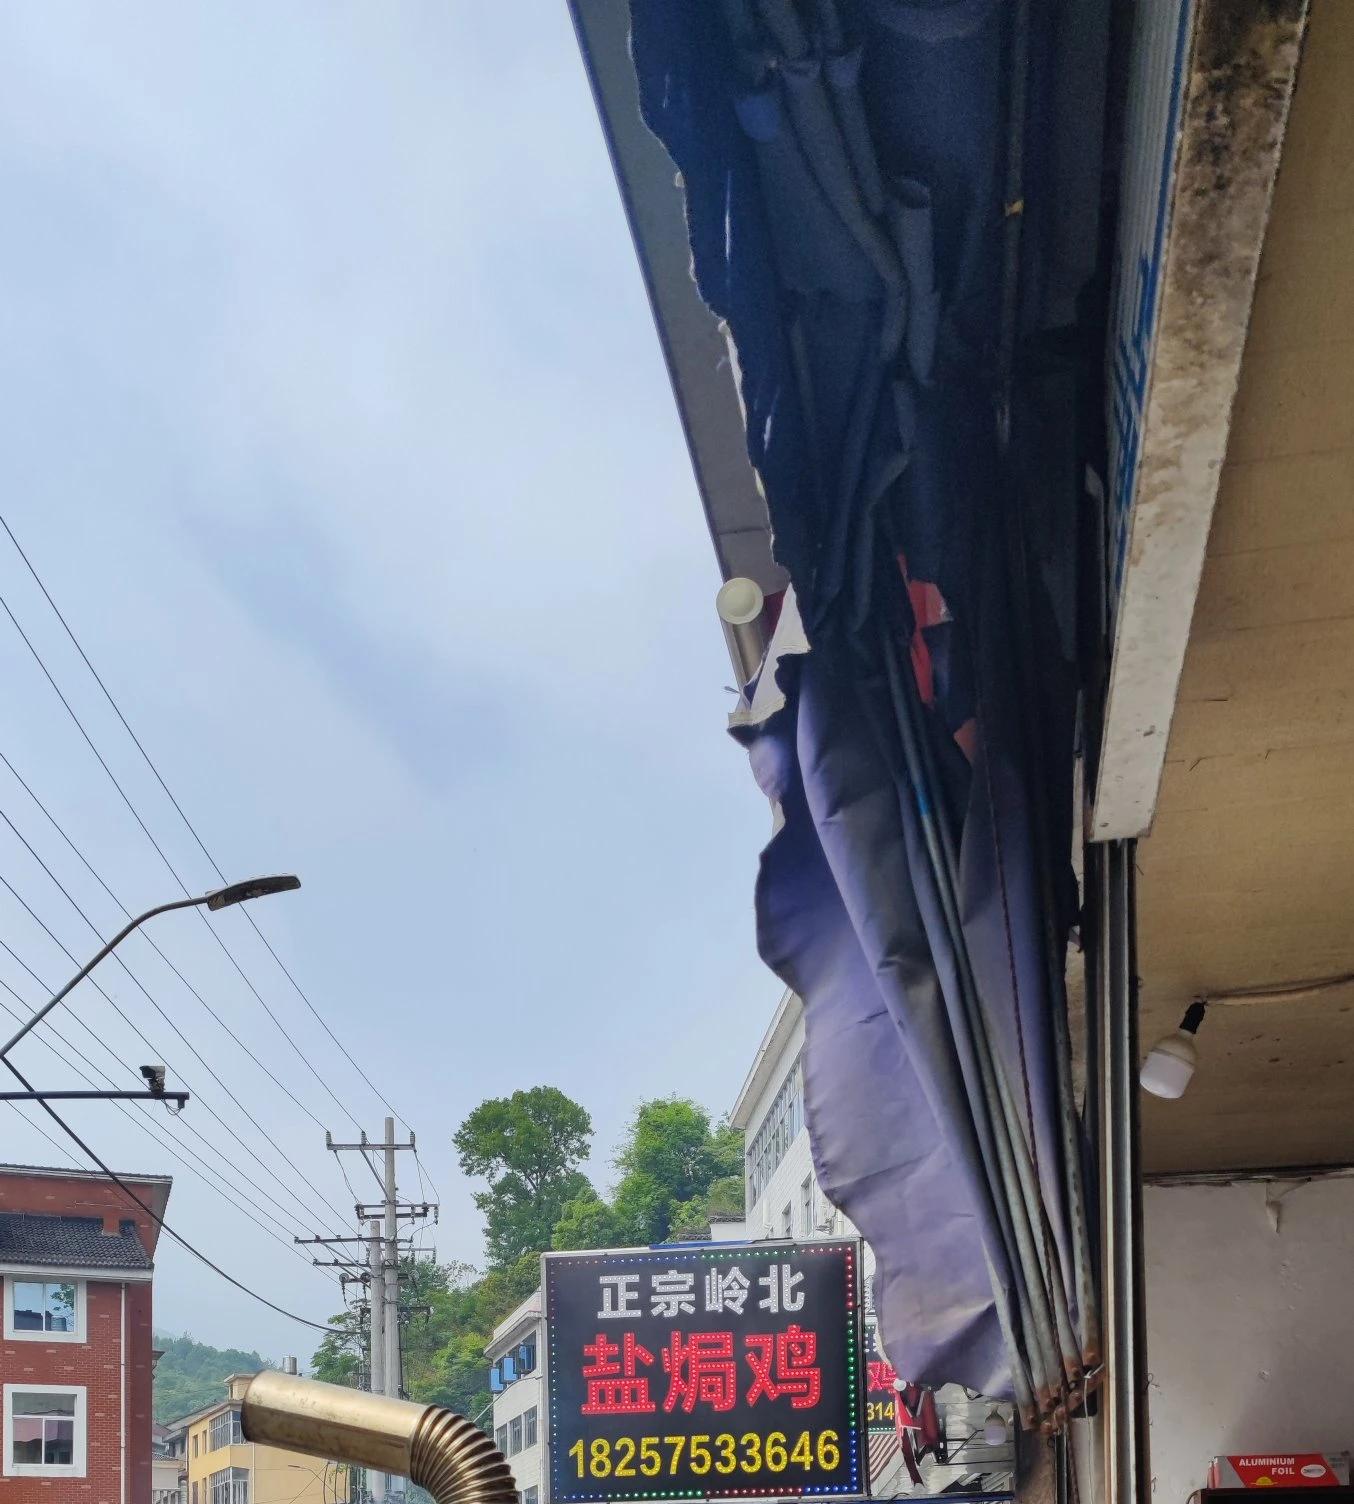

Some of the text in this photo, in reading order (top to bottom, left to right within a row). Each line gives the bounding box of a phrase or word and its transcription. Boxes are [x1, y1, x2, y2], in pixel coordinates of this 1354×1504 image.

[597, 1264, 805, 1319] 正宗岭北
[581, 1324, 822, 1415] 盐焗鸡
[568, 1429, 841, 1479] 18257533646
[1239, 1458, 1295, 1466] ALUMINIUM
[1271, 1467, 1295, 1475] FOIL
